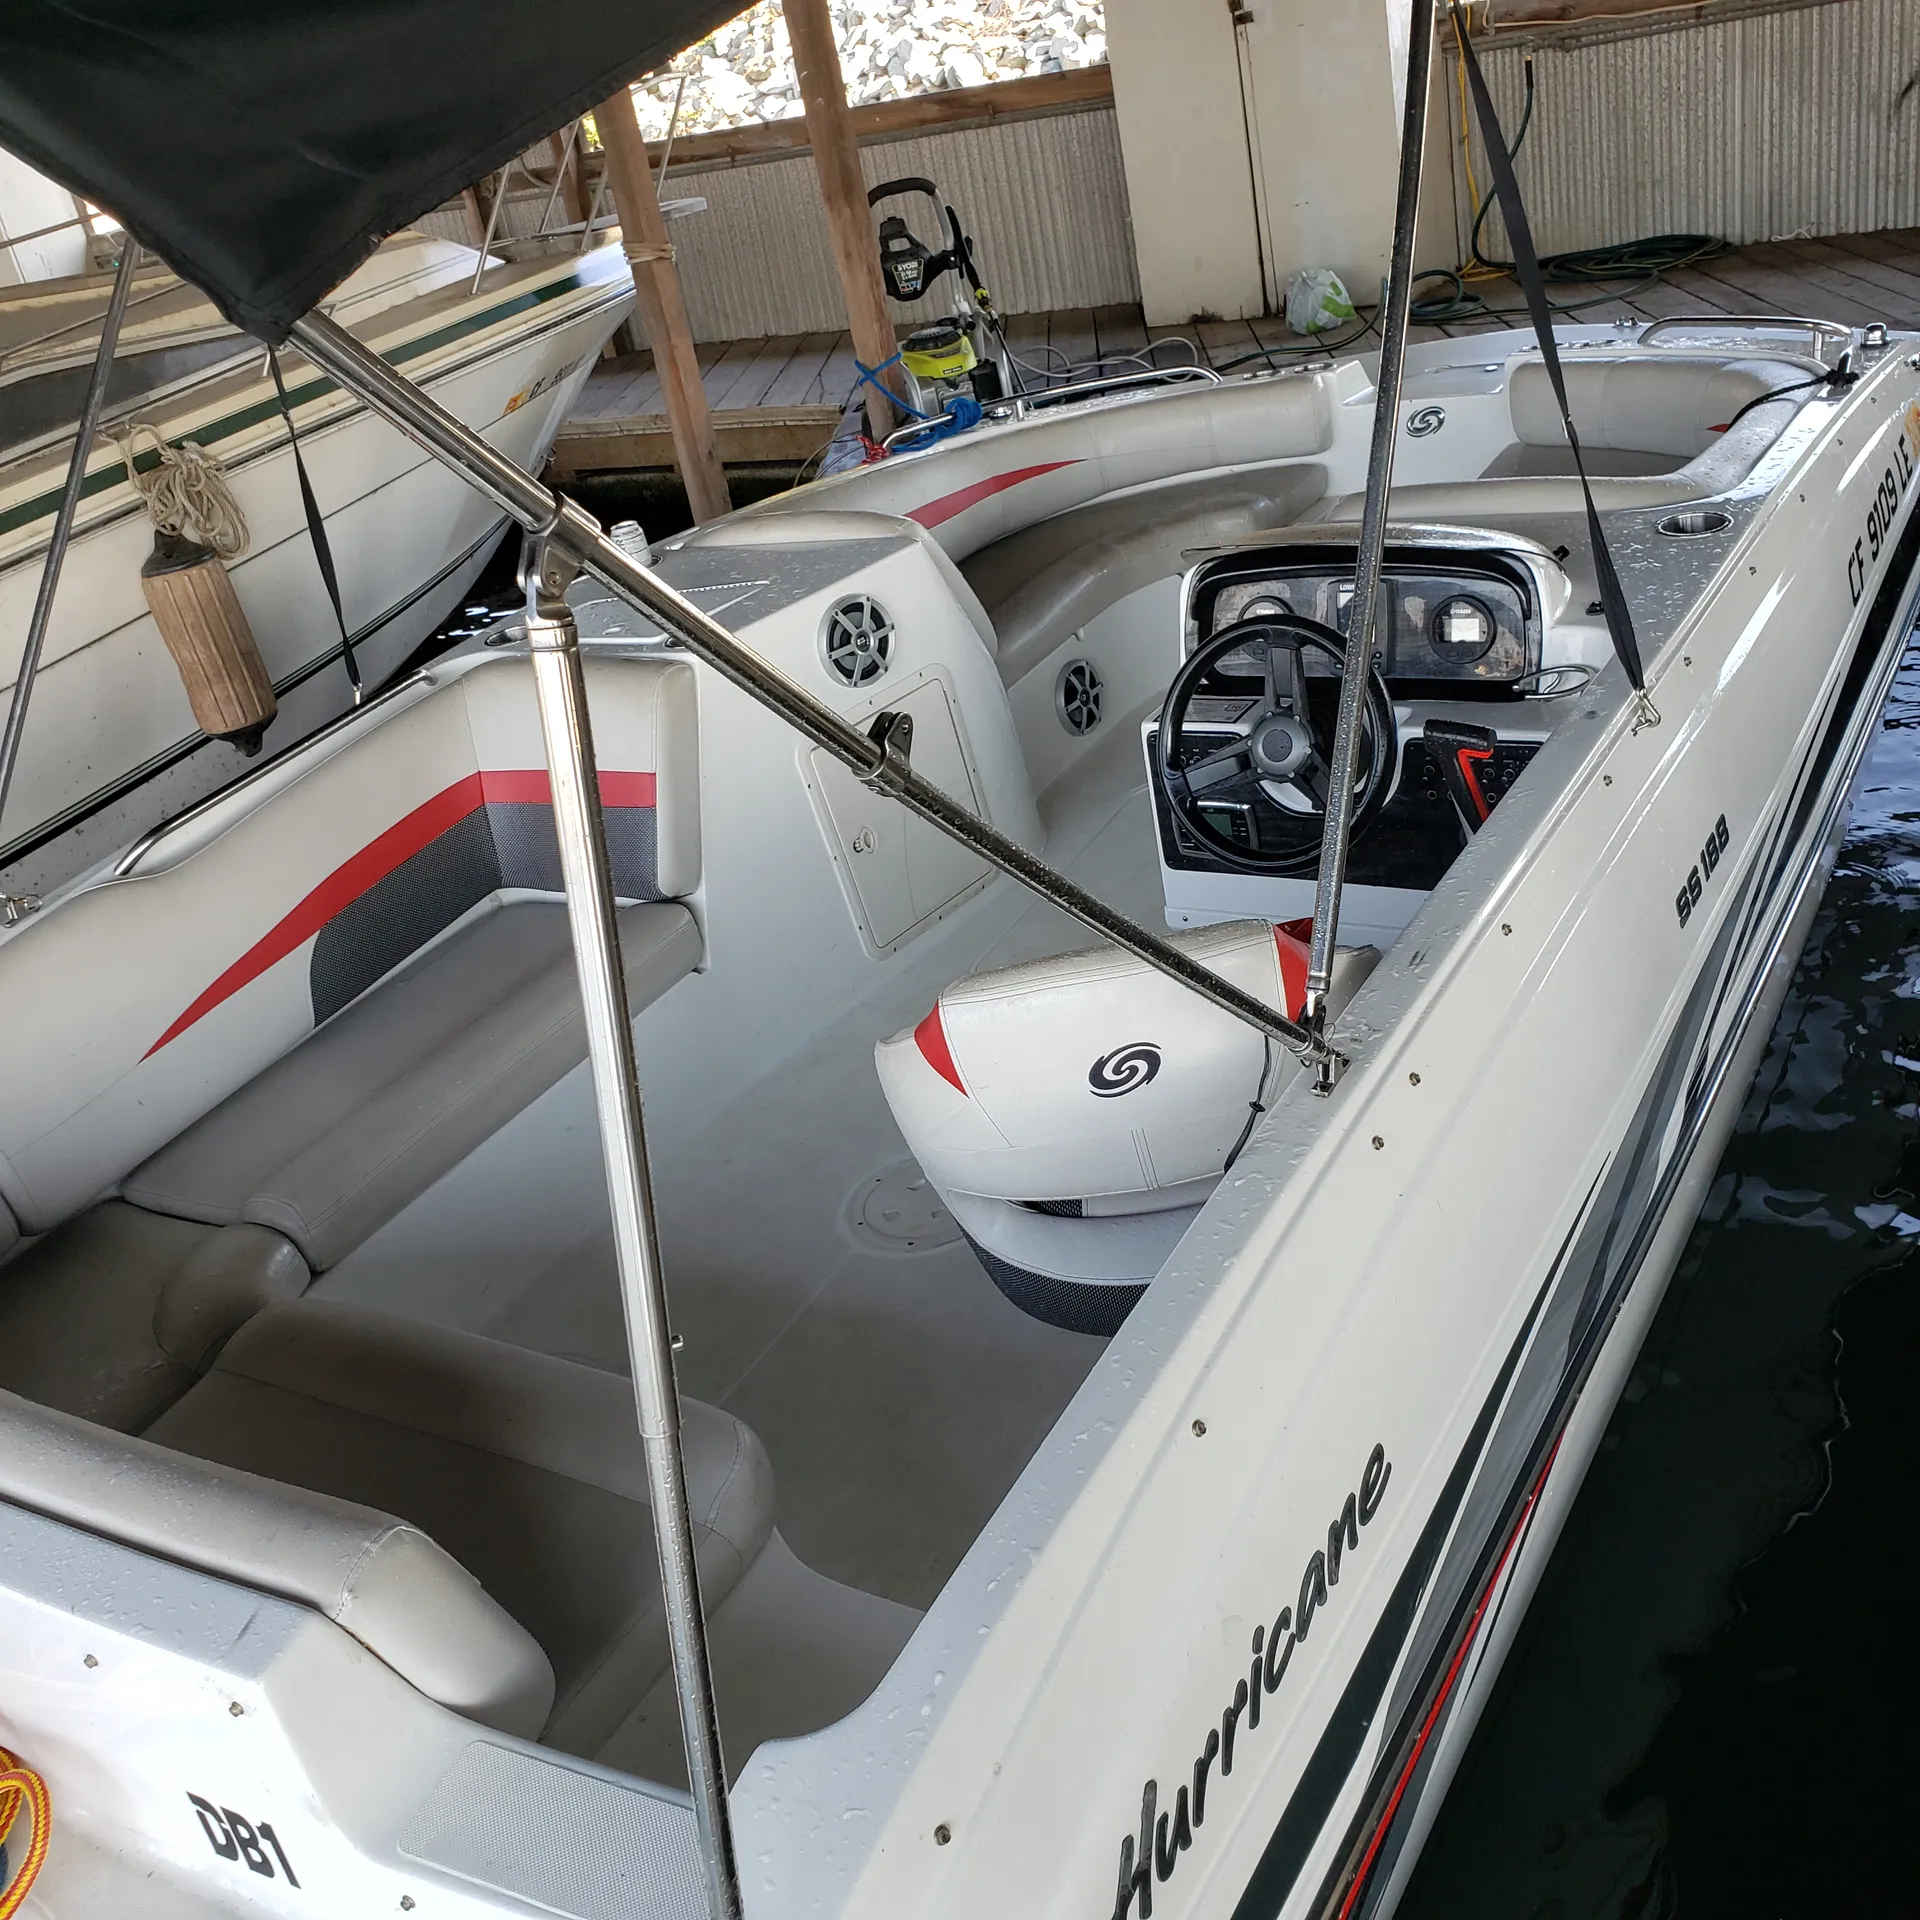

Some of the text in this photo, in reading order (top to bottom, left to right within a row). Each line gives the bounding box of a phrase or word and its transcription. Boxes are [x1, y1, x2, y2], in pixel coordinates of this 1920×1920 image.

[1848, 433, 1913, 607] CF 9109 LE
[1675, 813, 1730, 929] SS 188
[1111, 1442, 1392, 1920] Hurricane
[185, 1790, 302, 1889] DB1
